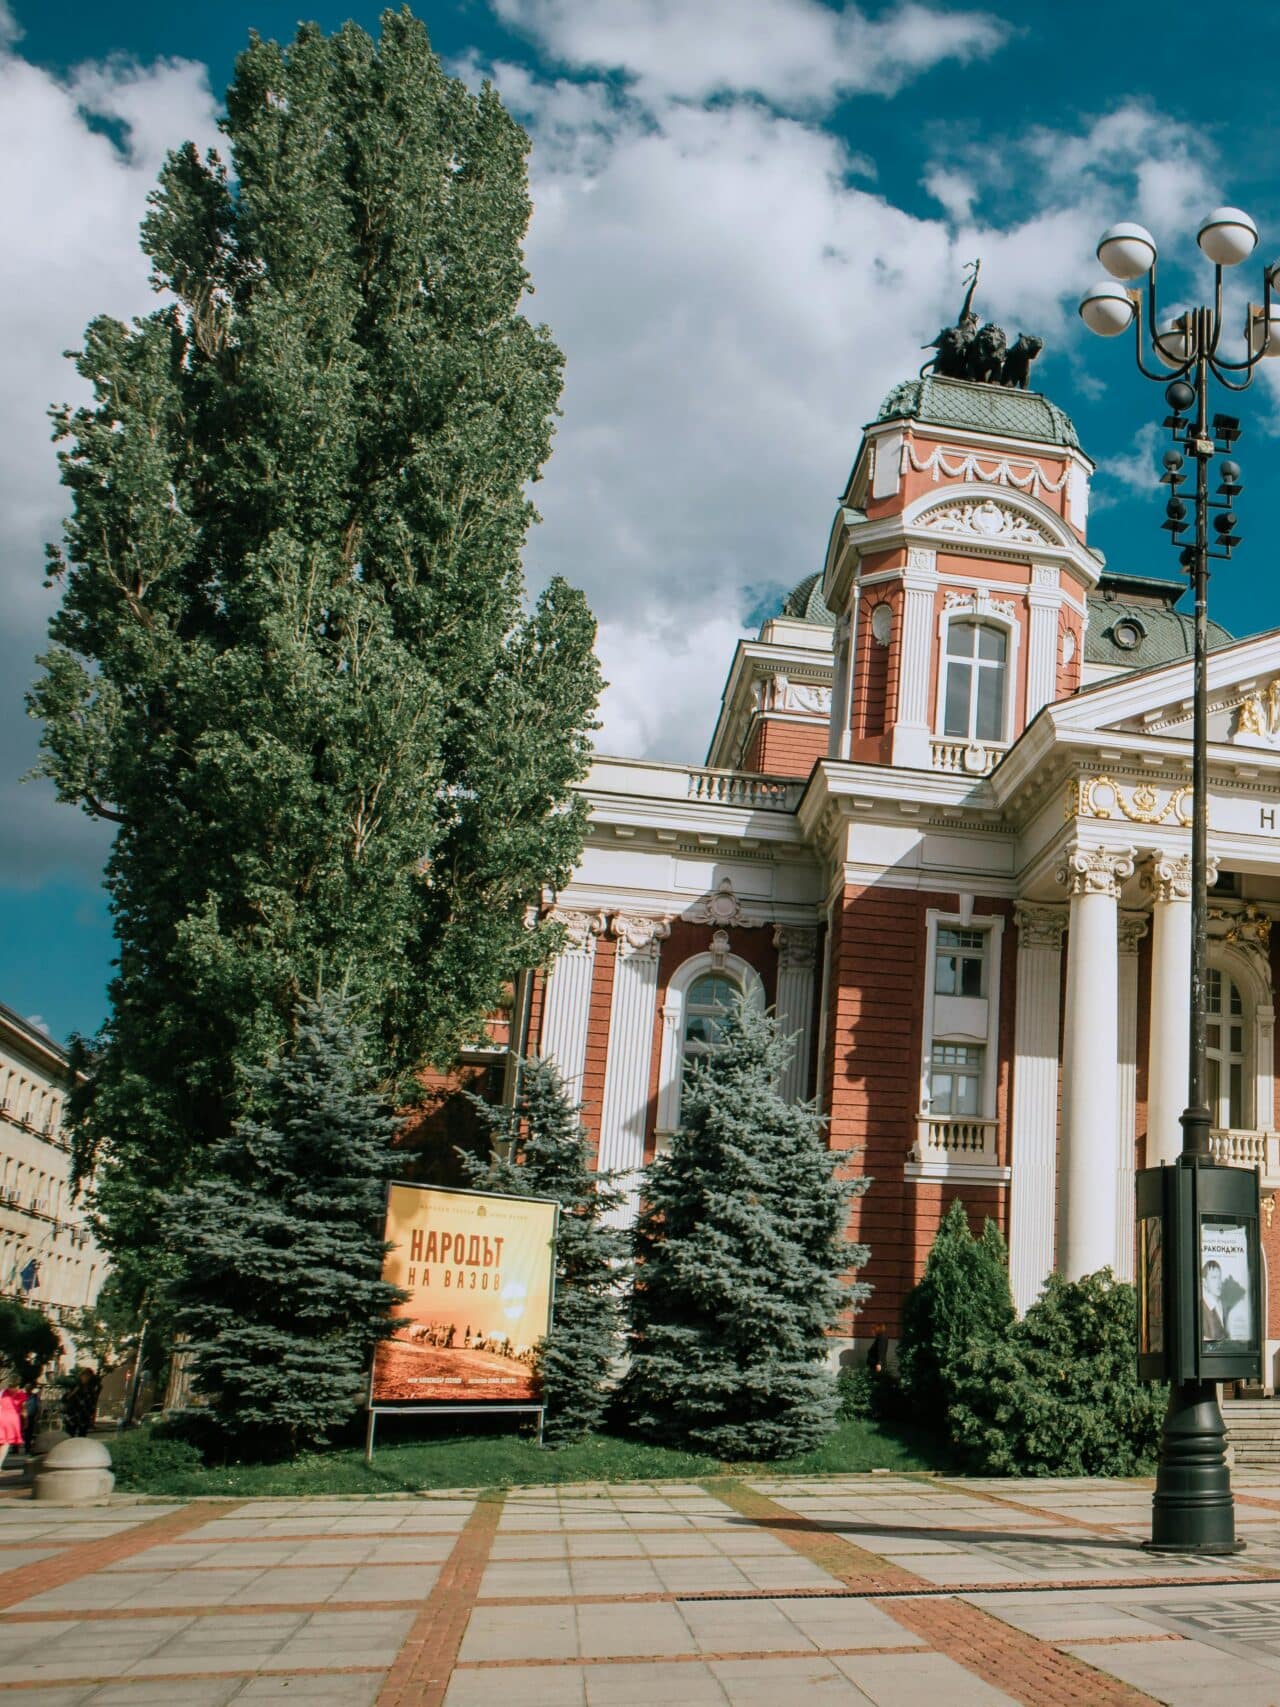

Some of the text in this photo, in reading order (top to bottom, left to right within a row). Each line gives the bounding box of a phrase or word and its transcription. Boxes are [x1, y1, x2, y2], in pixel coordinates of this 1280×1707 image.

[410, 1229, 504, 1268] НАРОДЪТ
[408, 1268, 500, 1290] НА ВАЗОВ
